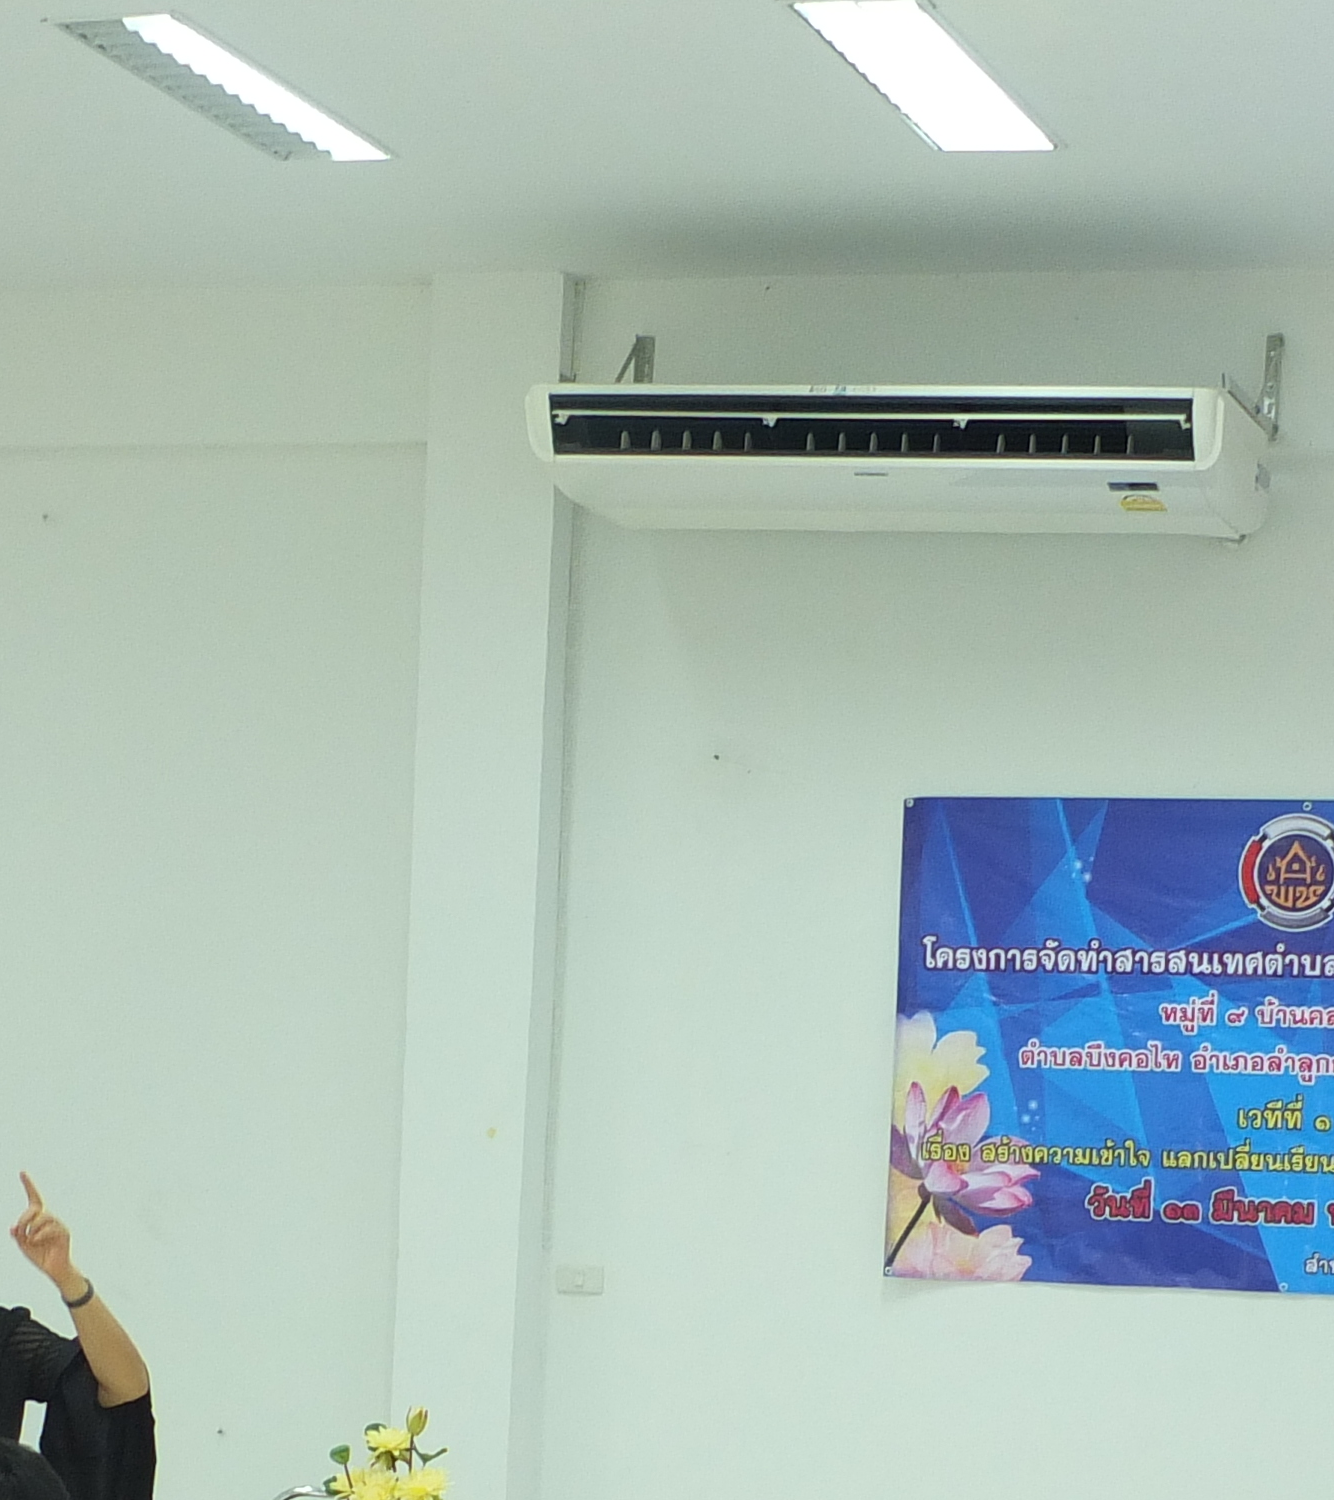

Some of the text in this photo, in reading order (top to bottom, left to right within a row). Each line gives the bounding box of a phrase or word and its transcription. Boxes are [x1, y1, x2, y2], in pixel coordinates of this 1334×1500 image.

[1160, 991, 1217, 1034] หมู่ที่
[1020, 1041, 1180, 1071] ตำบลบึงคอไห
[1237, 1094, 1331, 1132] เวทีที่ ๑
[921, 1131, 970, 1162] เรื่อง
[980, 1136, 1151, 1167] สร้างความเข้าใจ
[1086, 1178, 1153, 1221] วันที่
[1210, 1187, 1316, 1226] มีนาคม
